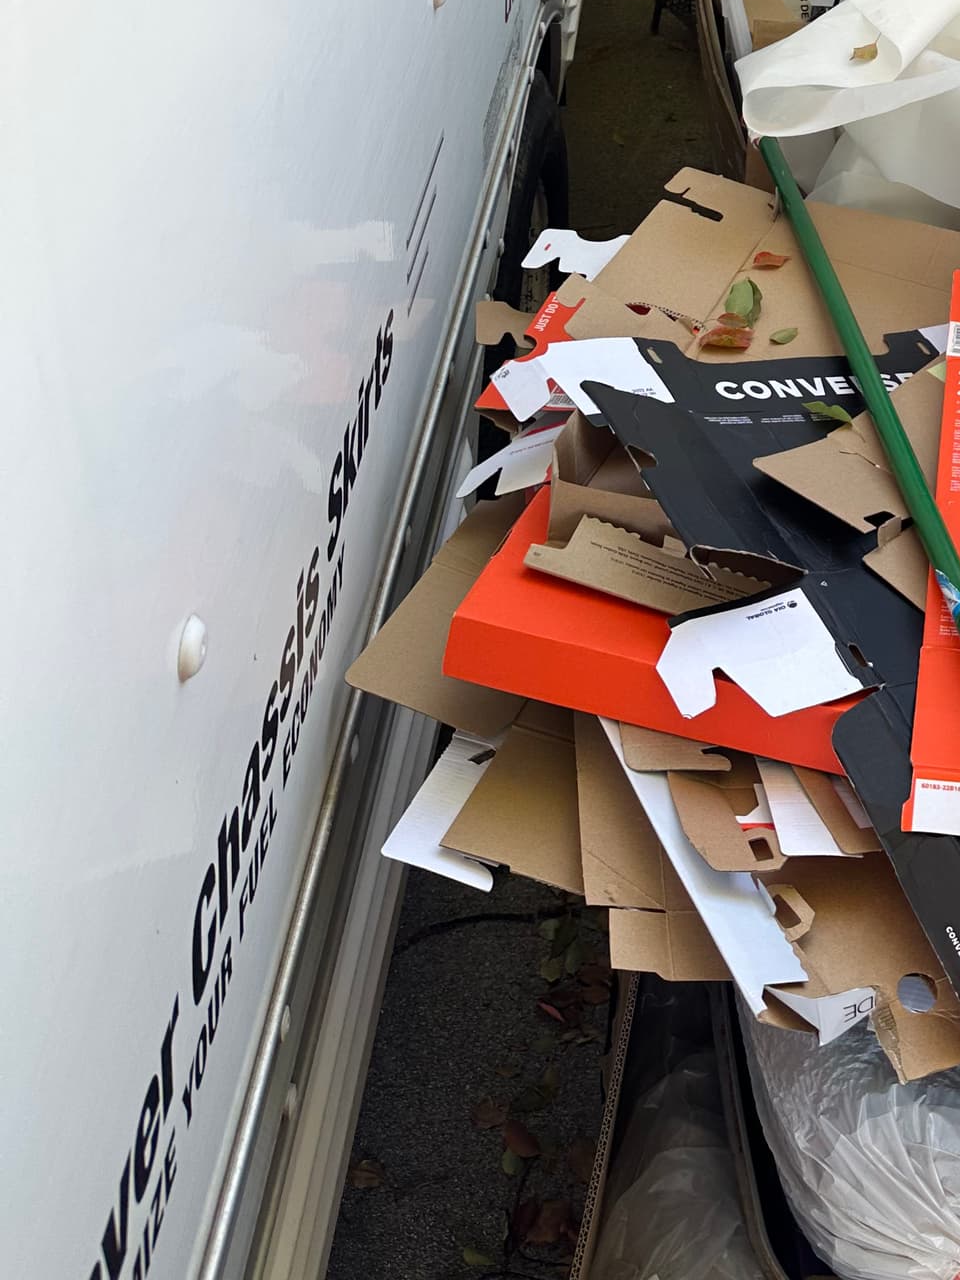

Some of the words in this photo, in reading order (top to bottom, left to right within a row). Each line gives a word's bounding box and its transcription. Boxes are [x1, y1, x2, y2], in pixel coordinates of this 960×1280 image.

[533, 311, 551, 333] JUST
[543, 301, 558, 316] DO
[714, 371, 914, 400] CONVESE
[744, 609, 773, 621] GLOBAL
[88, 991, 179, 1280] ver
[191, 546, 320, 1007] Chassis
[326, 308, 395, 561] Skirts
[132, 1126, 178, 1280] IZE
[182, 936, 234, 1128] YOUR
[239, 791, 278, 942] FUEL
[282, 540, 347, 790] ECONOMY
